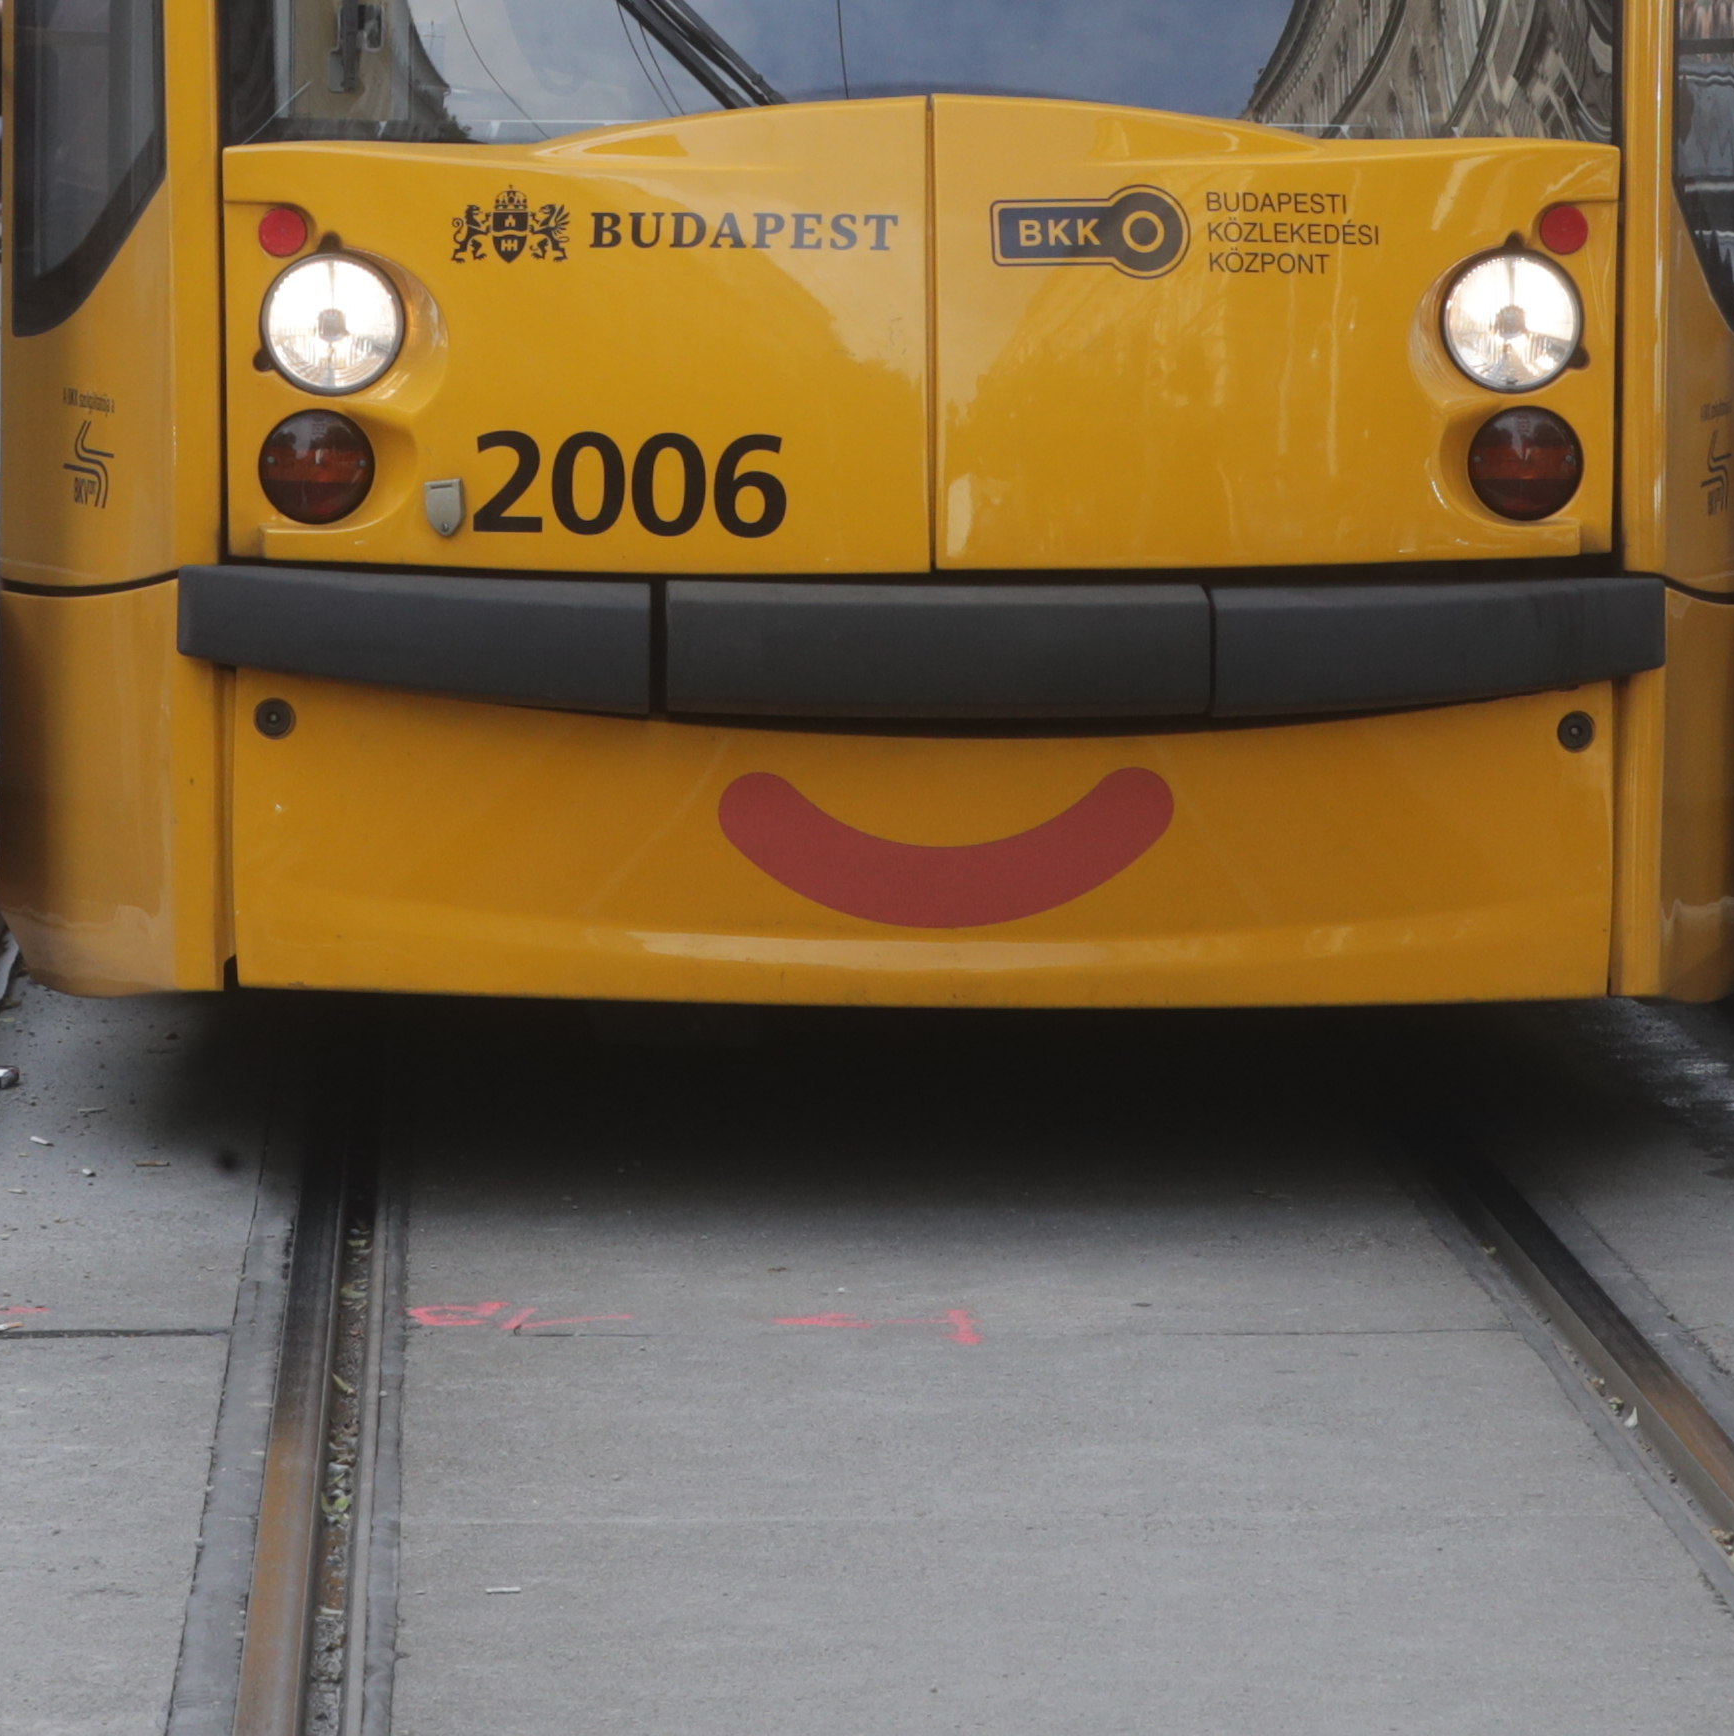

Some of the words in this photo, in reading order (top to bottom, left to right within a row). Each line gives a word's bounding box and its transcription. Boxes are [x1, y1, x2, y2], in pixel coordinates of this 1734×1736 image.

[1205, 191, 1348, 215] BUDAPESTI
[589, 211, 899, 251] BUDAPEST
[1018, 217, 1103, 247] BKK
[1206, 216, 1380, 246] KÖZLEKEDÉSI
[1208, 246, 1330, 275] KÖZPONT
[472, 430, 788, 539] 2006
